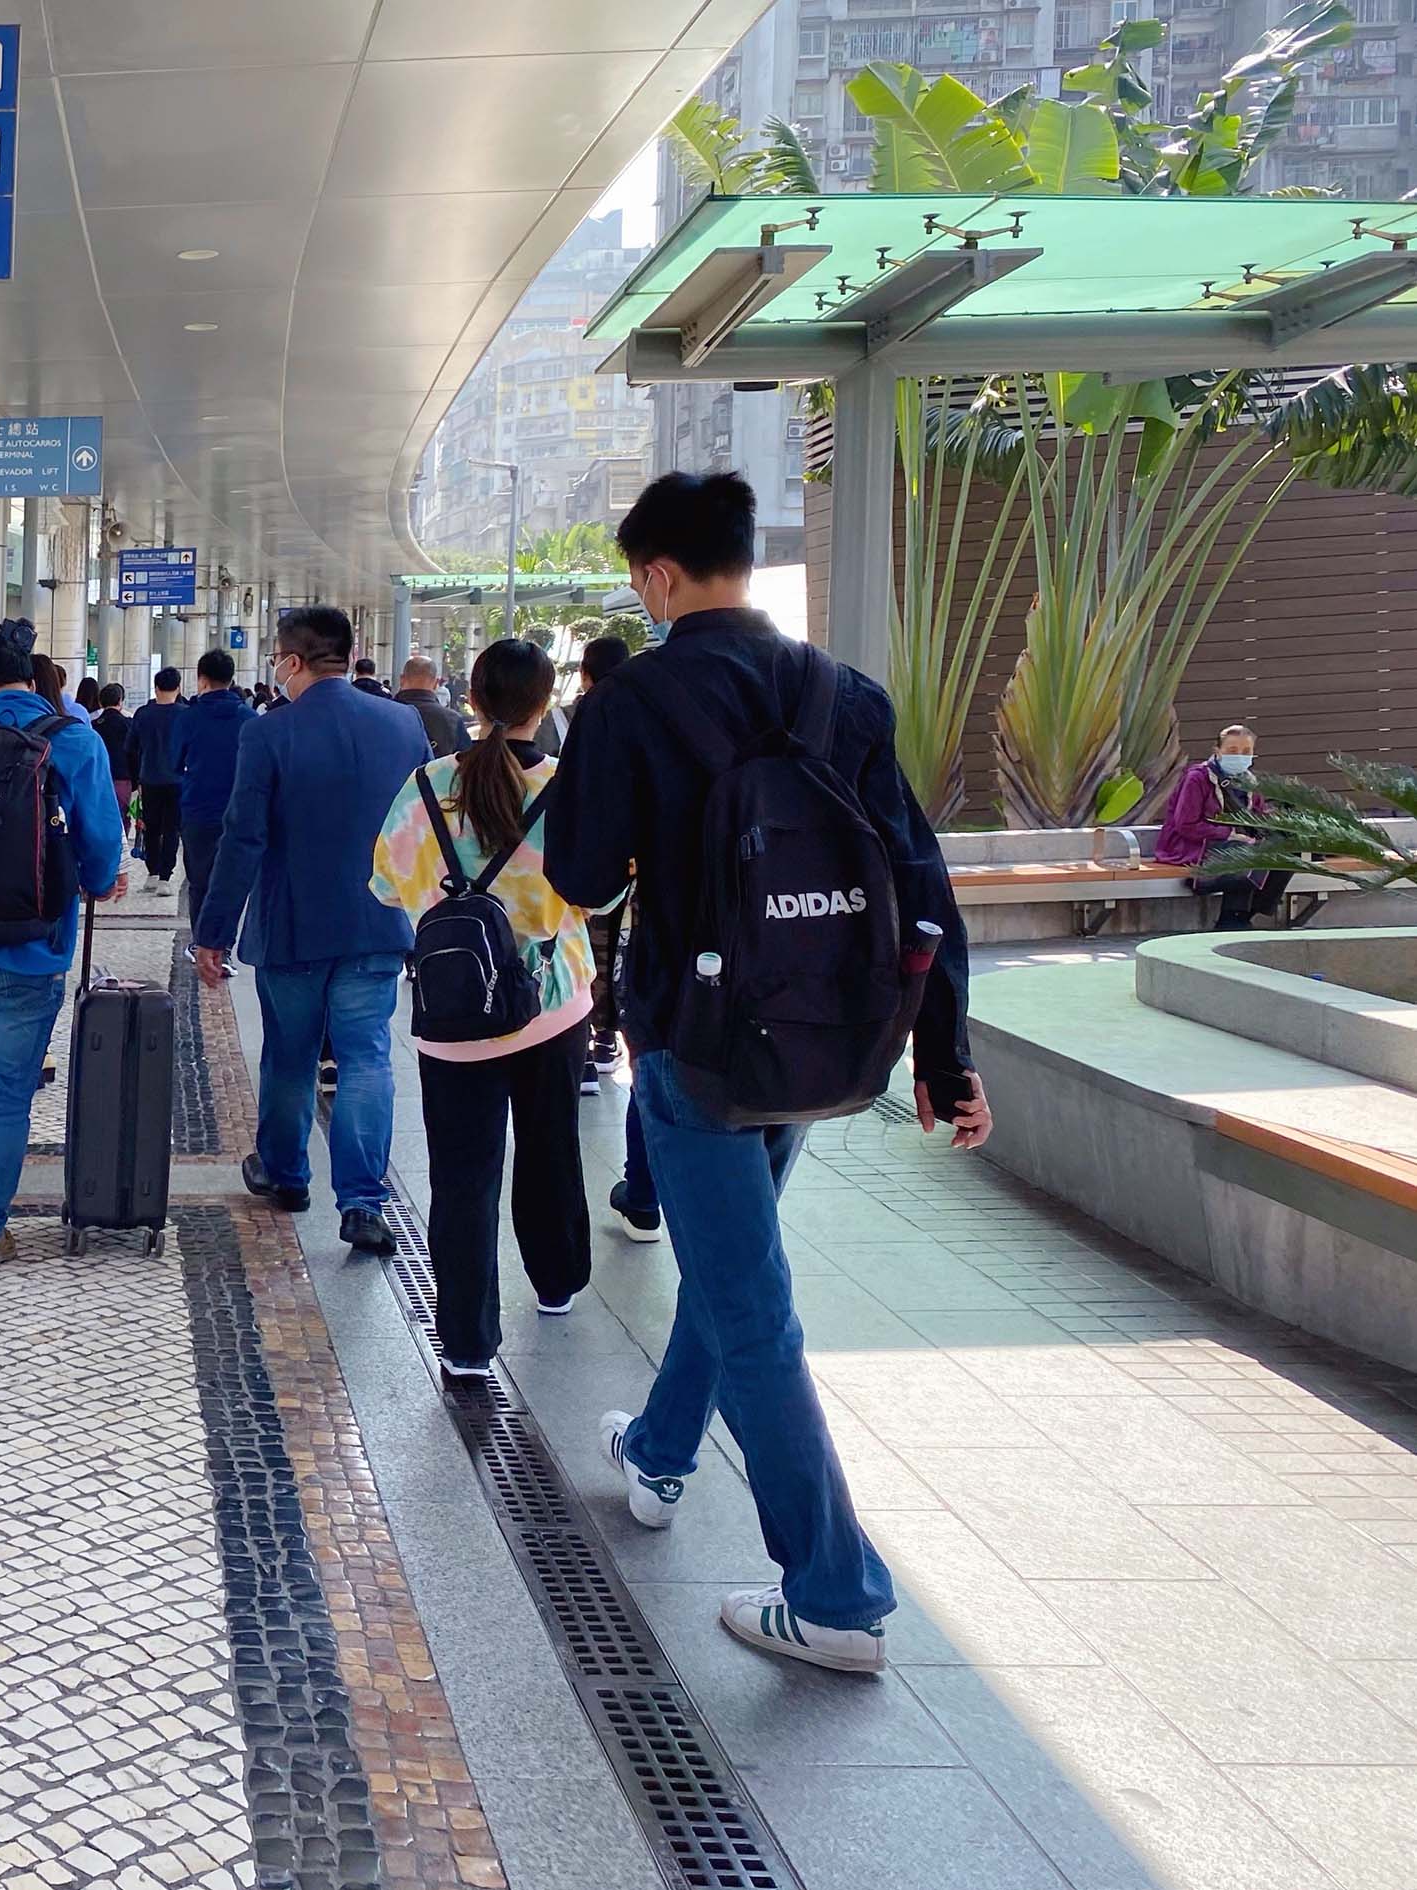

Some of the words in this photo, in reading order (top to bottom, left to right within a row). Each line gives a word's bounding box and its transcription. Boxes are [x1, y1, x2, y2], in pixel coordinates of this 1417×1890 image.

[6, 439, 61, 447] AUTOCARROS
[42, 467, 59, 475] LIFT
[765, 887, 867, 919] ADIDAS
